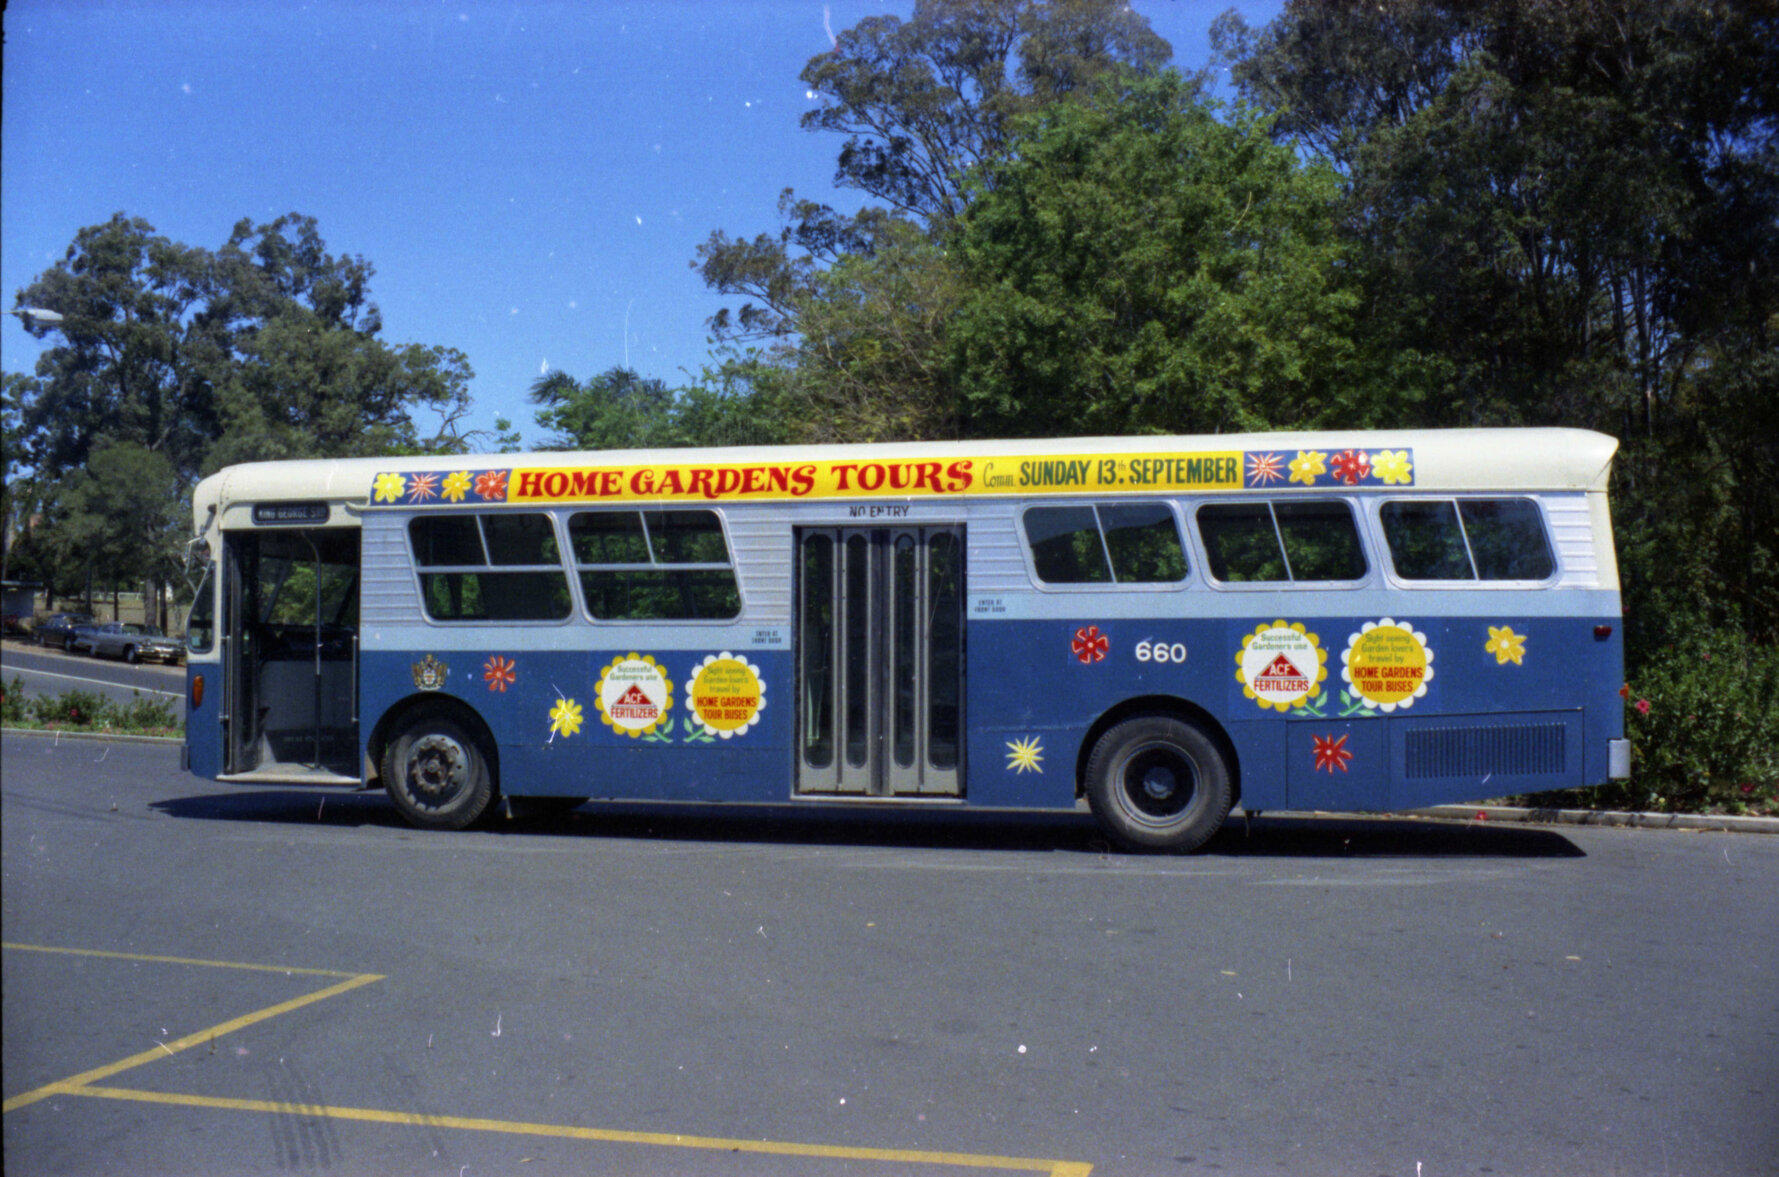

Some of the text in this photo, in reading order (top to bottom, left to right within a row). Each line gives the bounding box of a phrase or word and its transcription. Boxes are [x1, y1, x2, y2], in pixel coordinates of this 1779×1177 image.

[516, 471, 624, 498] HOME
[630, 464, 817, 499] GARDENS
[830, 460, 973, 493] TOURS
[1019, 459, 1092, 487] SUNDAY
[1128, 457, 1238, 485] SEPTEMBER
[849, 505, 910, 518] NO ENTRY
[1261, 633, 1301, 641] Successful
[1365, 633, 1384, 644] Sight
[1135, 641, 1187, 663] 660
[1361, 643, 1390, 652] Garden
[1368, 654, 1405, 664] travel by
[618, 664, 652, 672] Successful
[1269, 663, 1291, 676] ACF
[1354, 666, 1423, 678] HOME GARDENS
[731, 686, 741, 694] by
[1254, 679, 1309, 692] FERTILIZERS
[1361, 680, 1414, 692] TOUR BUSES
[624, 692, 643, 704] ACF
[696, 696, 757, 707] HOME GARDENS
[611, 707, 658, 718] FERTILIZERS
[703, 709, 748, 720] TOUR BUSES
